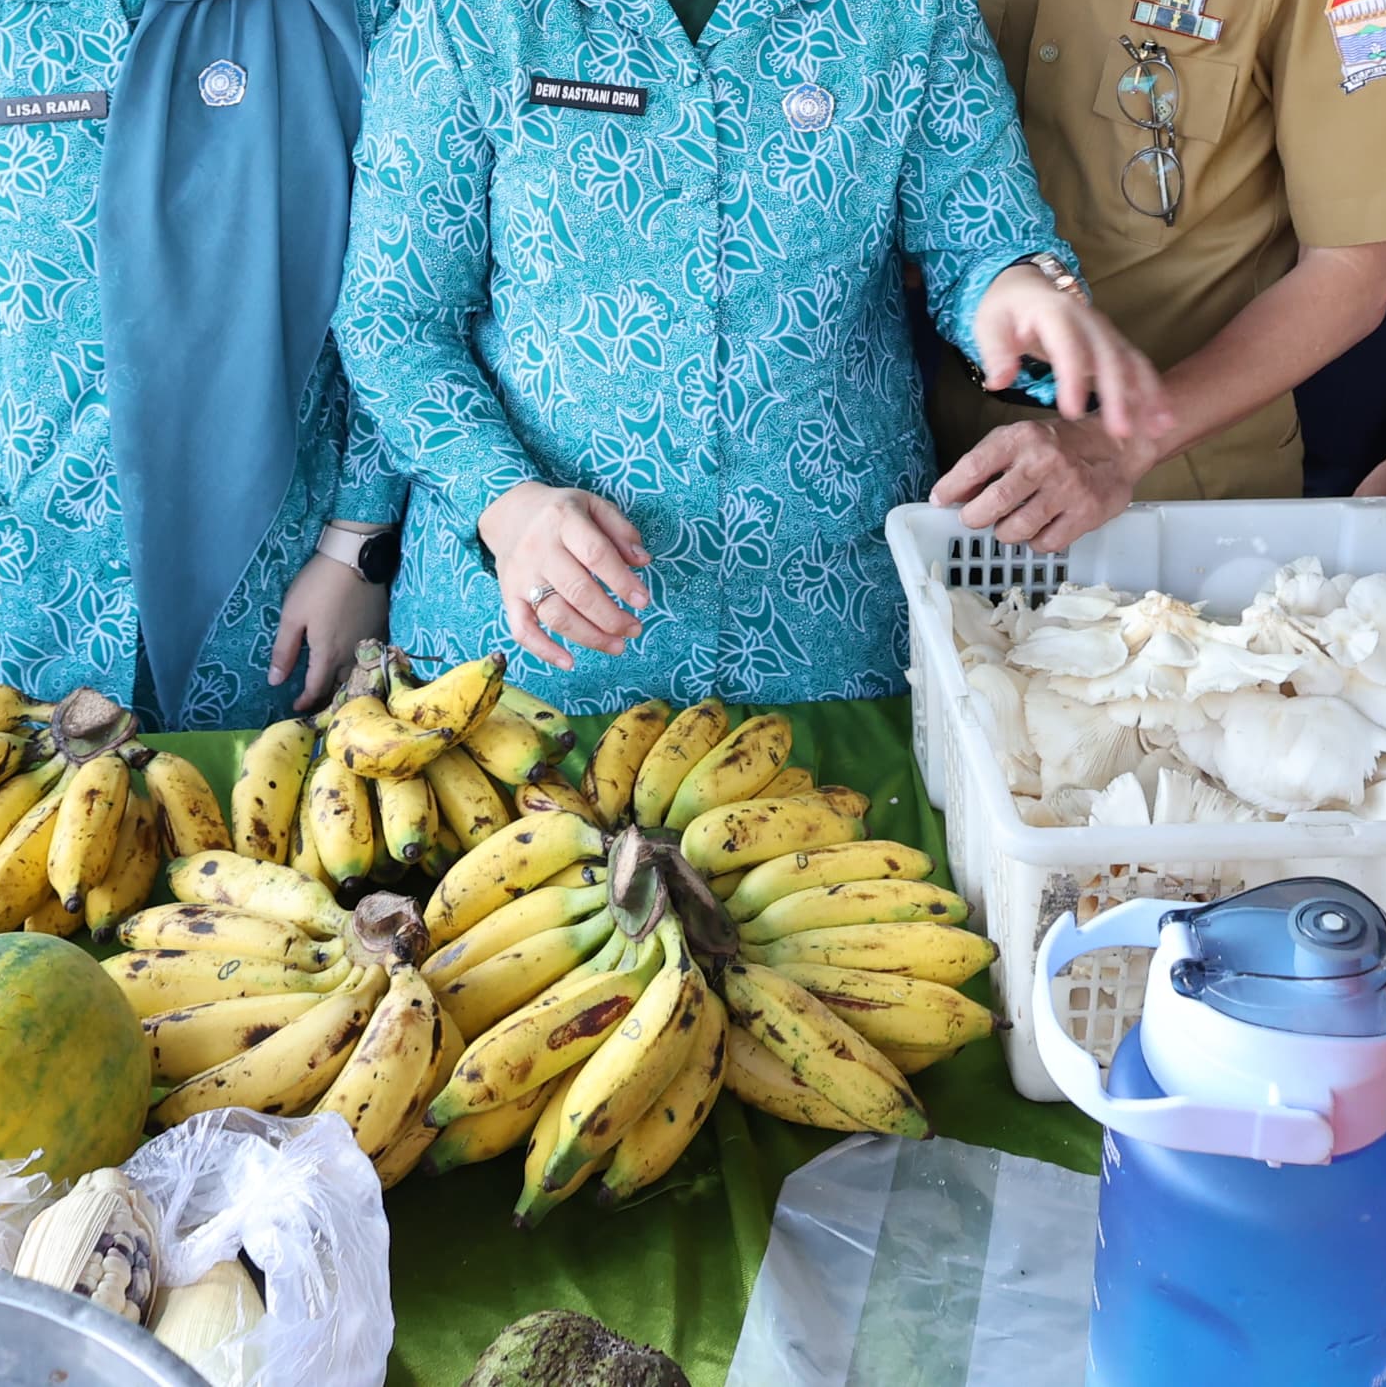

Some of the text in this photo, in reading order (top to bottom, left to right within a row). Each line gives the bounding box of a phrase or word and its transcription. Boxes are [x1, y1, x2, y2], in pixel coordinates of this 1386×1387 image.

[535, 83, 640, 108] DEWI SASTRANI DEWA
[6, 99, 92, 117] LISA RAMA
